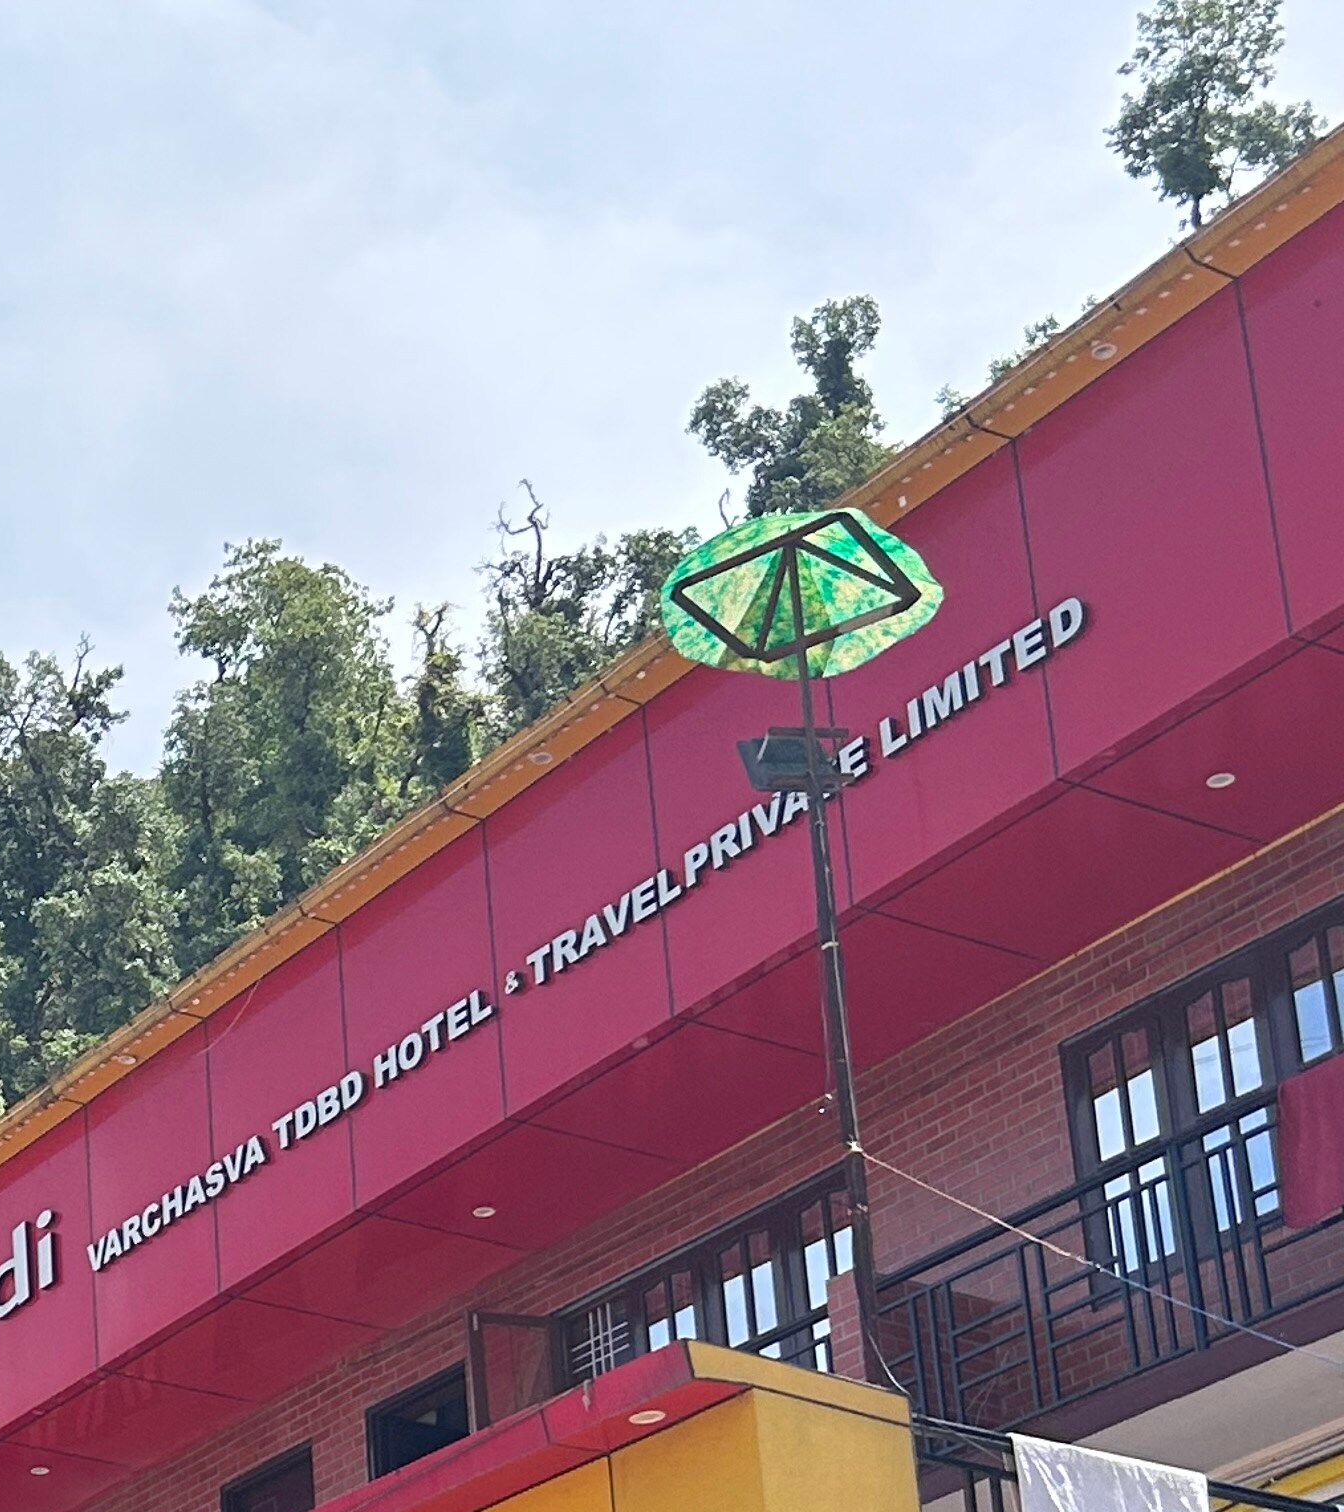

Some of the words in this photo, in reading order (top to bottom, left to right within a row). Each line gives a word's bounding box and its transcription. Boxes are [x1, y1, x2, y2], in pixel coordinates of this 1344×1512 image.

[87, 1136, 266, 1273] VARCHASVA
[272, 1070, 364, 1149] TDBD
[373, 989, 494, 1088] HOTEL
[504, 970, 520, 995] &
[526, 870, 681, 985] TRAVEL
[683, 736, 869, 888] PRIVAE
[878, 597, 1086, 758] LIMITED
